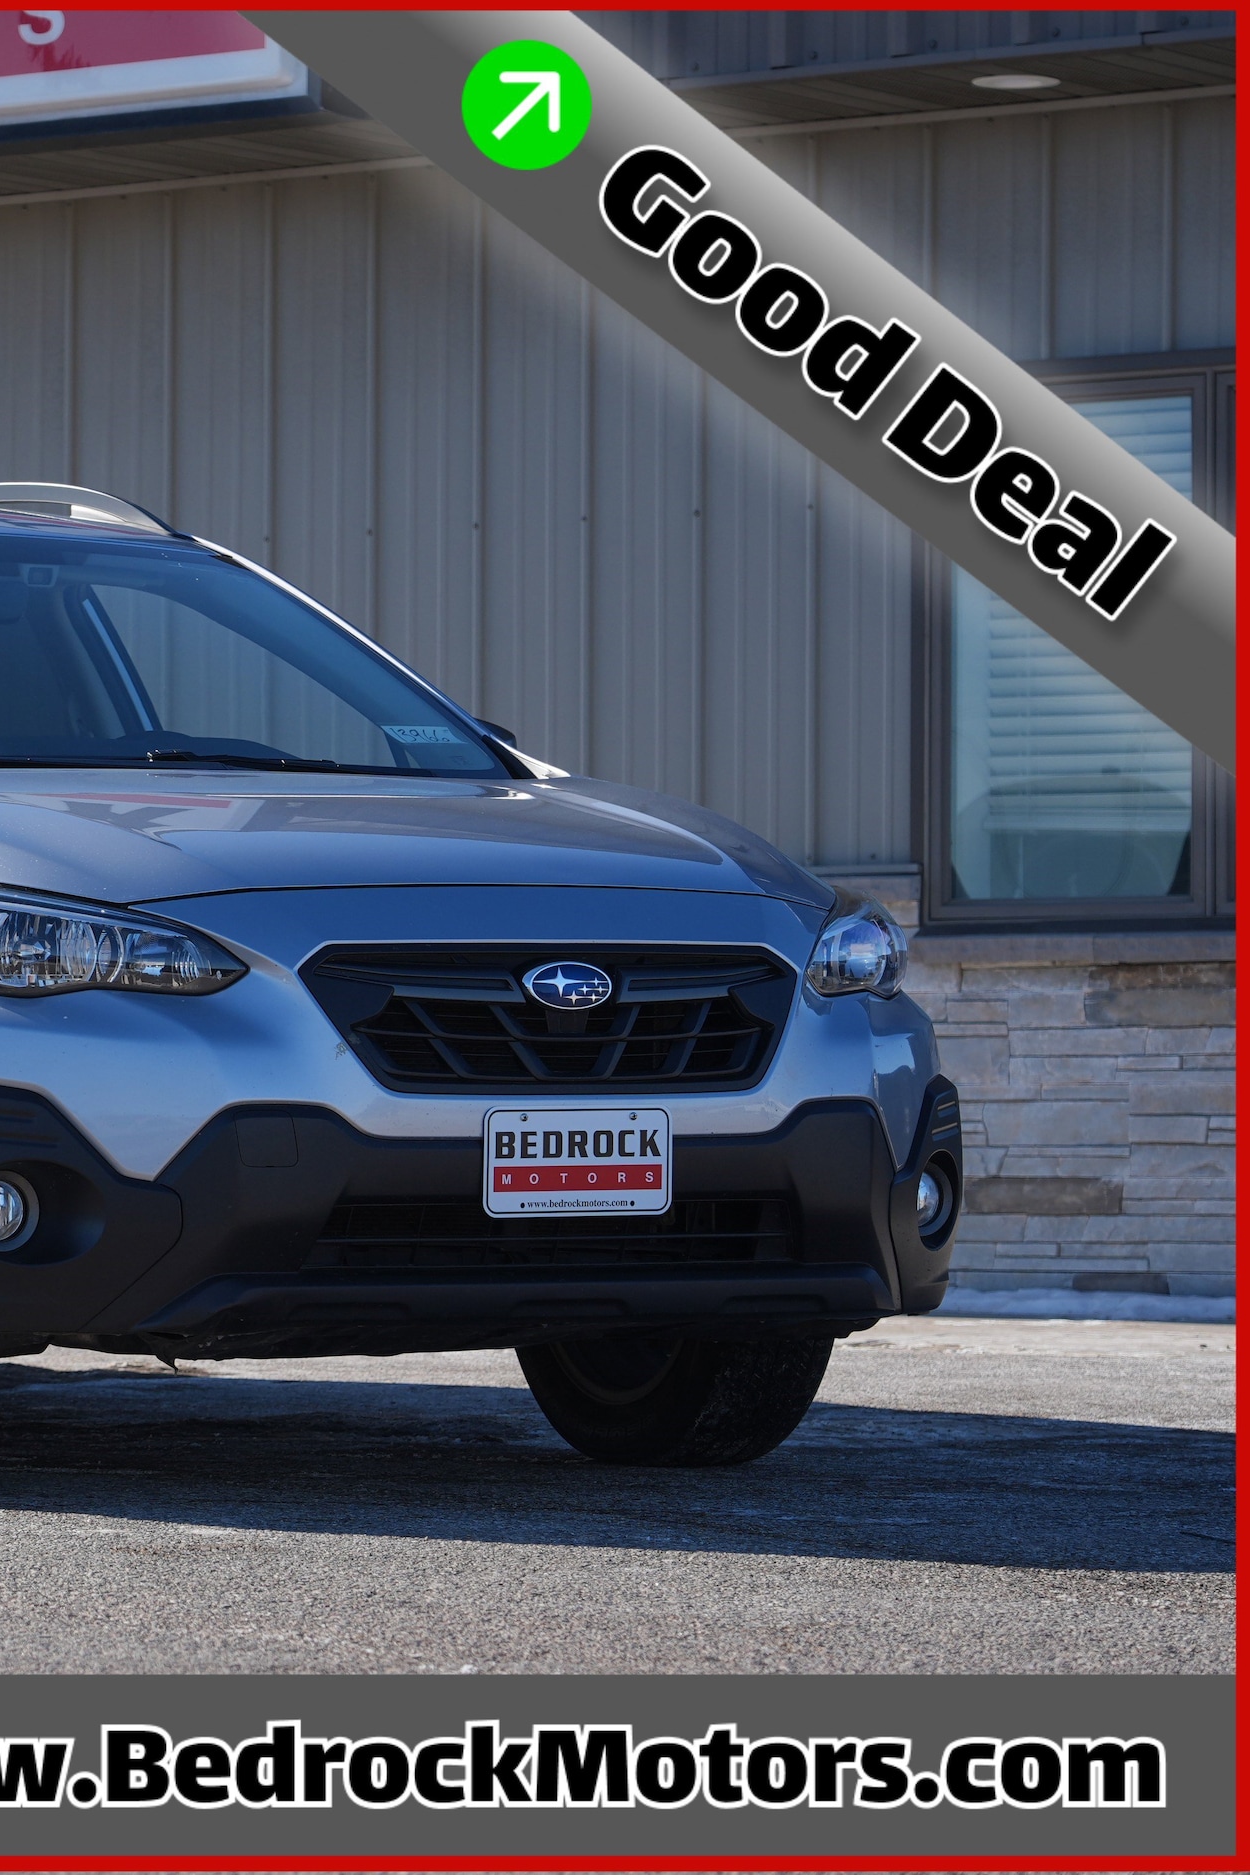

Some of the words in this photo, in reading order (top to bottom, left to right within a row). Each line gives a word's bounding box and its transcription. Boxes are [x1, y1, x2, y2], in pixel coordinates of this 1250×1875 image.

[494, 1129, 662, 1160] BEDROCK
[501, 1171, 655, 1186] MOTORS
[527, 1199, 628, 1209] www.bedrockmotors.com
